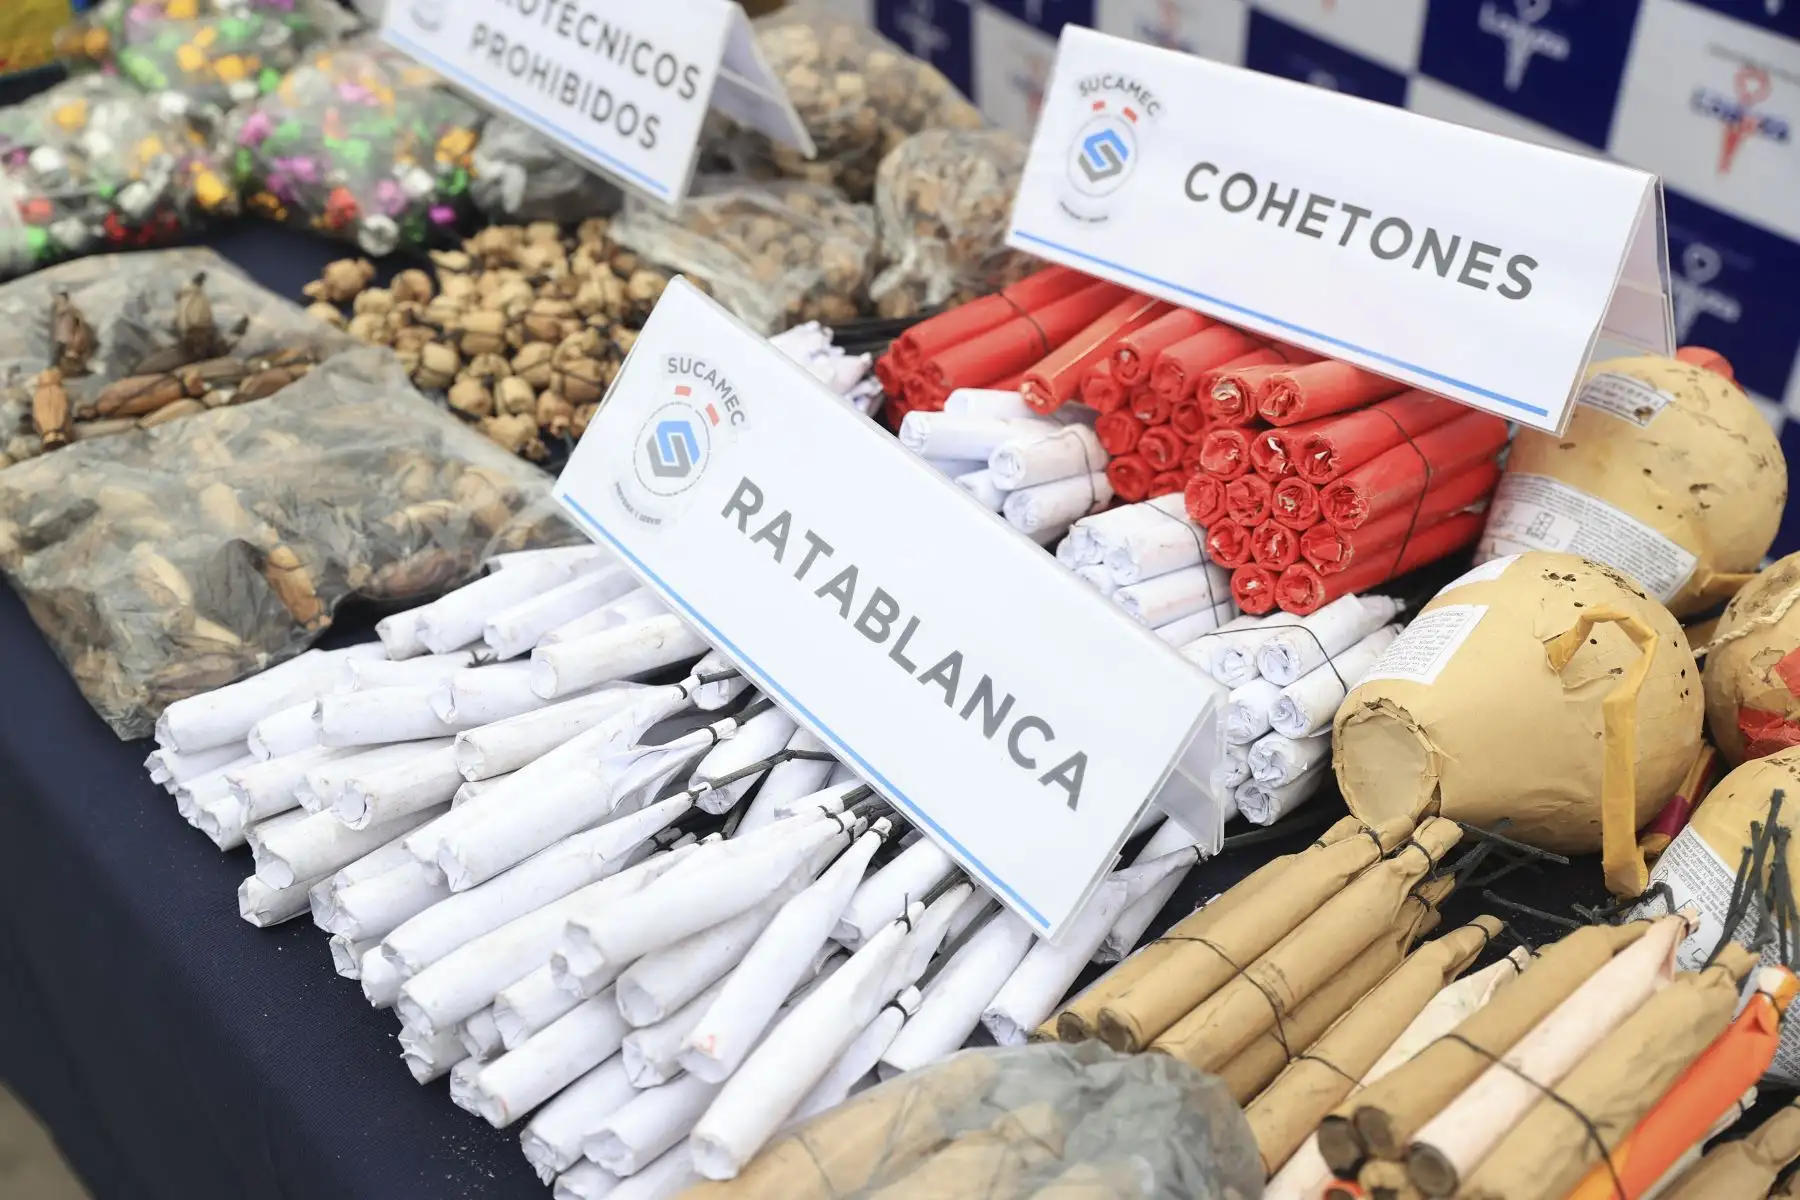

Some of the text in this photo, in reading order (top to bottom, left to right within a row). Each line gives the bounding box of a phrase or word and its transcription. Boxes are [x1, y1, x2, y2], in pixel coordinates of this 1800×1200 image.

[471, 23, 661, 150] PROHIBIDOS
[503, 0, 702, 101] OTECNICOS
[1079, 75, 1161, 116] SUCAMEC
[1184, 162, 1539, 300] COHETONES
[667, 356, 745, 427] SUCAMEC
[721, 476, 1089, 812] RATABLANCA
